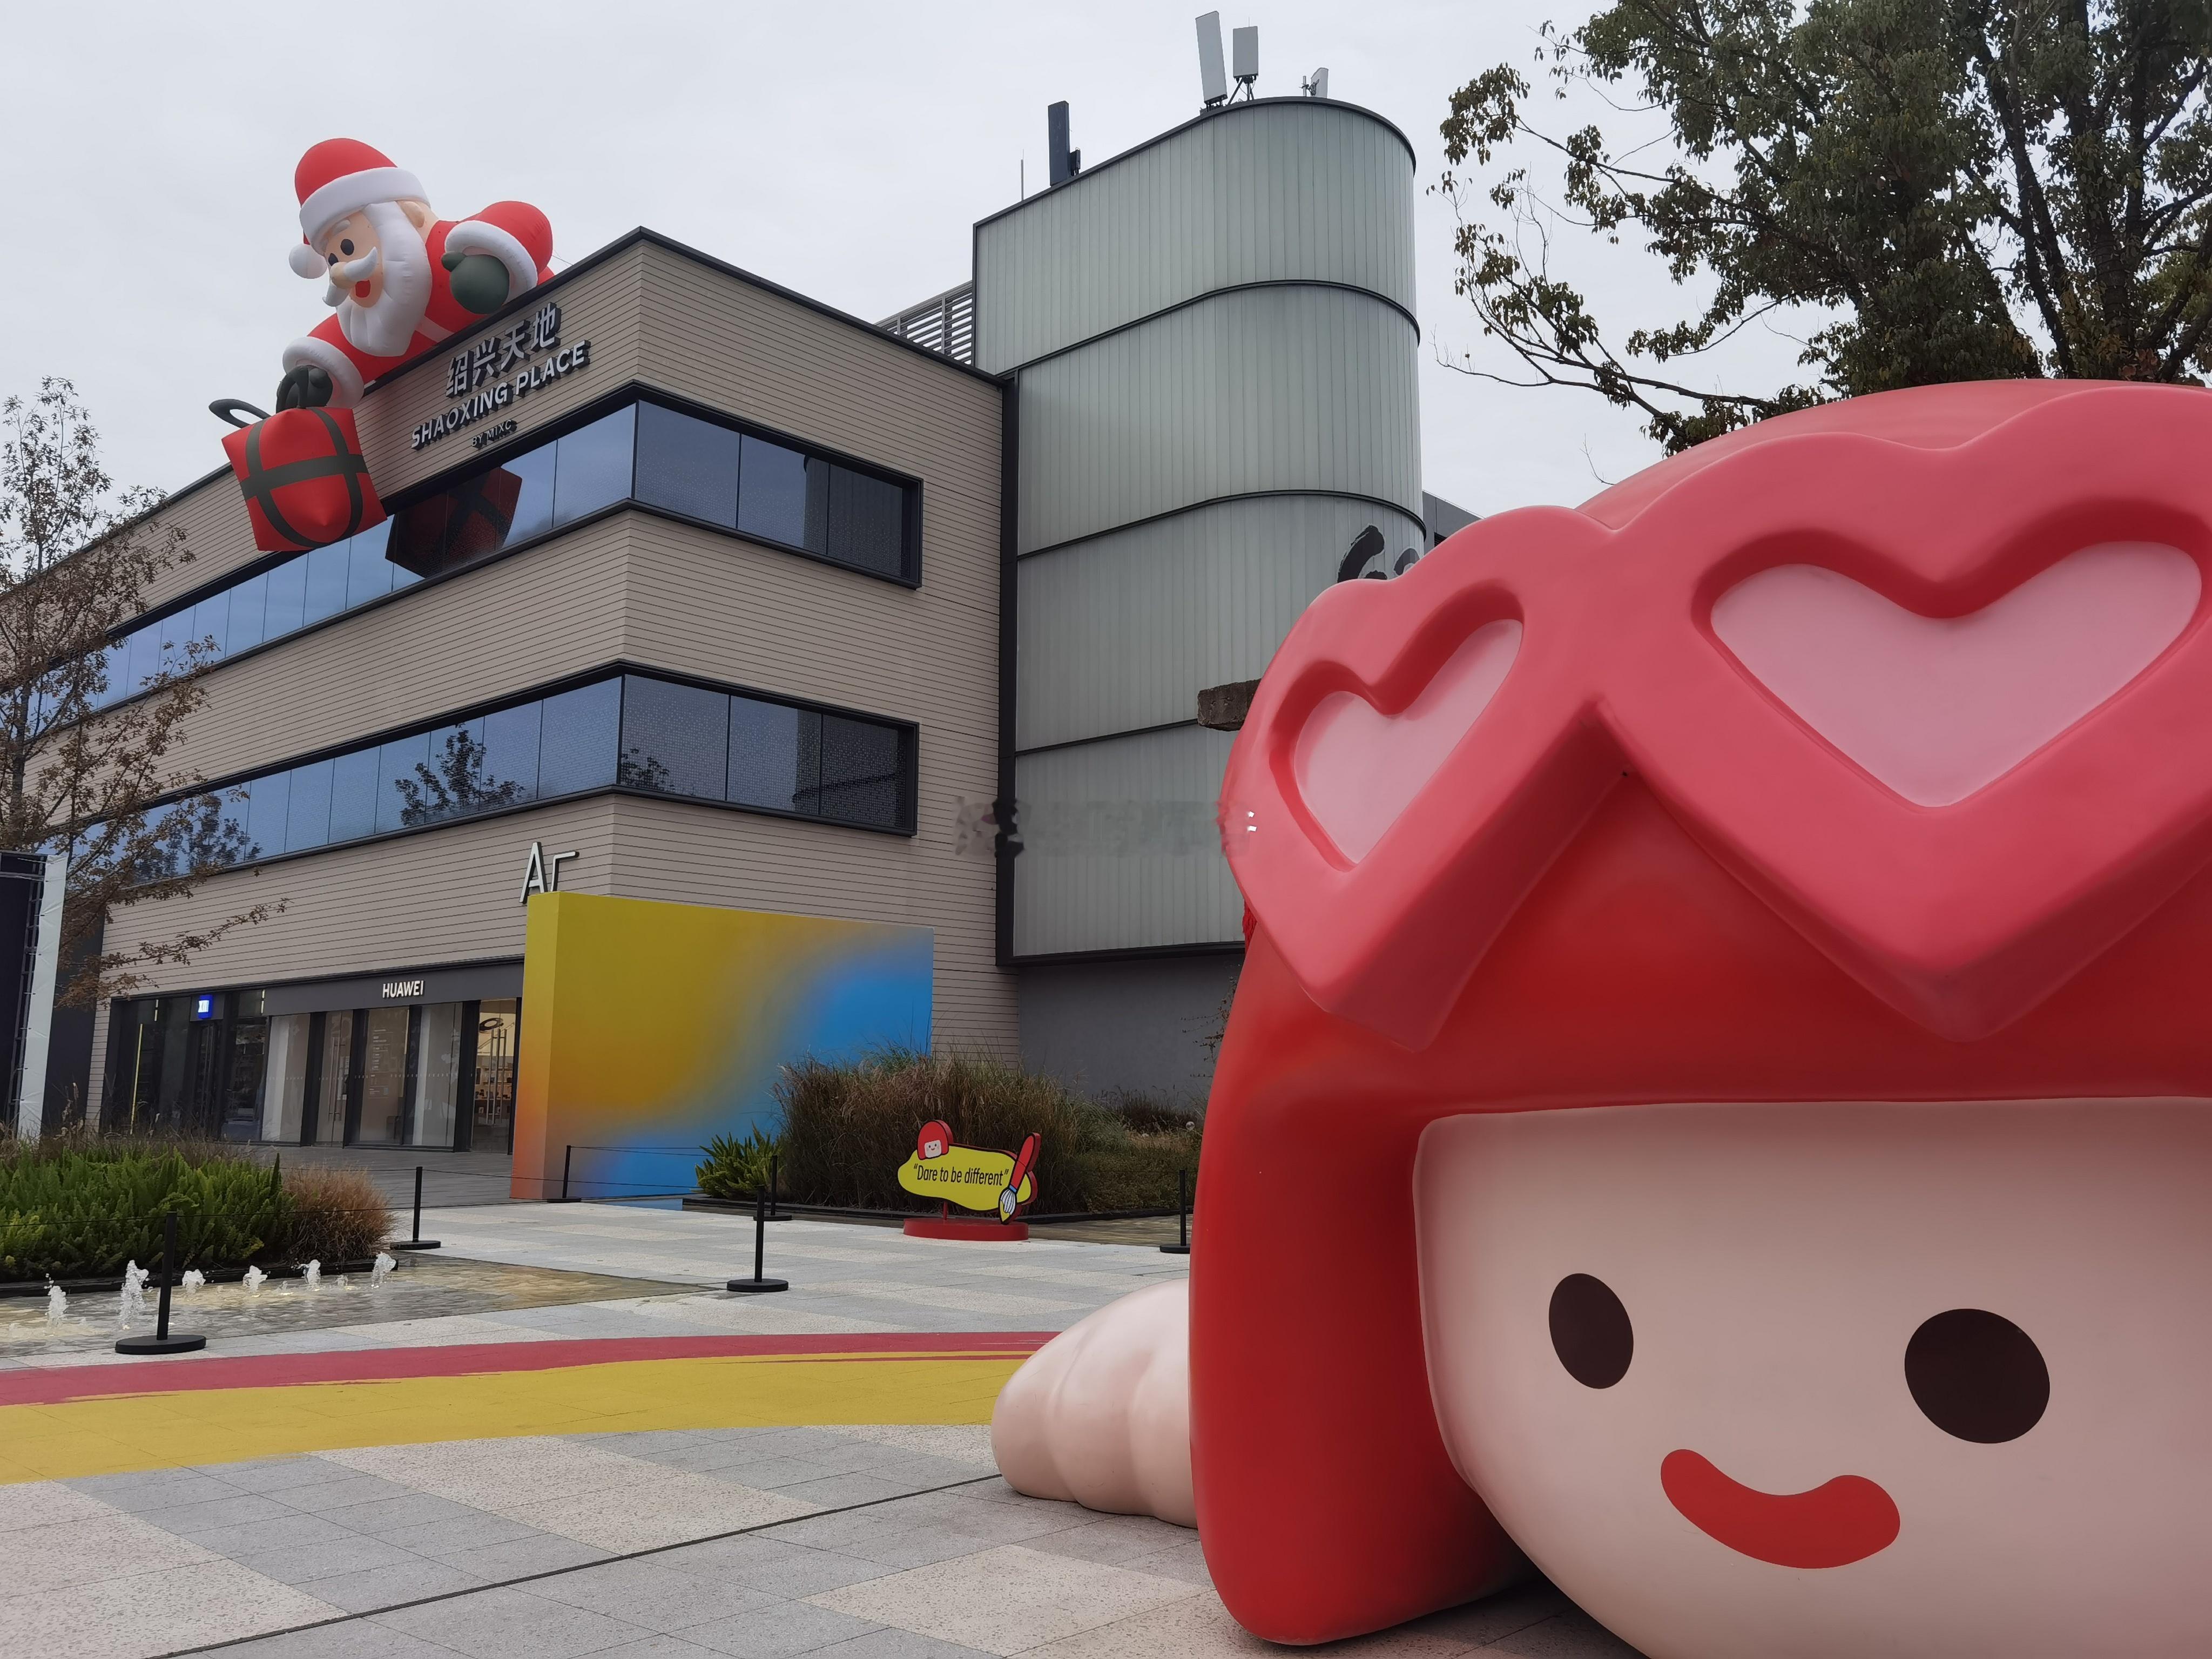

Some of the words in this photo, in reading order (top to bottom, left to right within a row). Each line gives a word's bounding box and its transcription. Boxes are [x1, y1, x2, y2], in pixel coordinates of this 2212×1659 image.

[446, 302, 561, 398] 绍兴天地
[411, 381, 511, 450] SHAOXING
[515, 340, 590, 397] PLACE
[471, 433, 485, 448] BY
[484, 419, 515, 440] MIXC
[382, 980, 424, 999] HUAWEI
[940, 1167, 949, 1182] to
[950, 1166, 962, 1183] be
